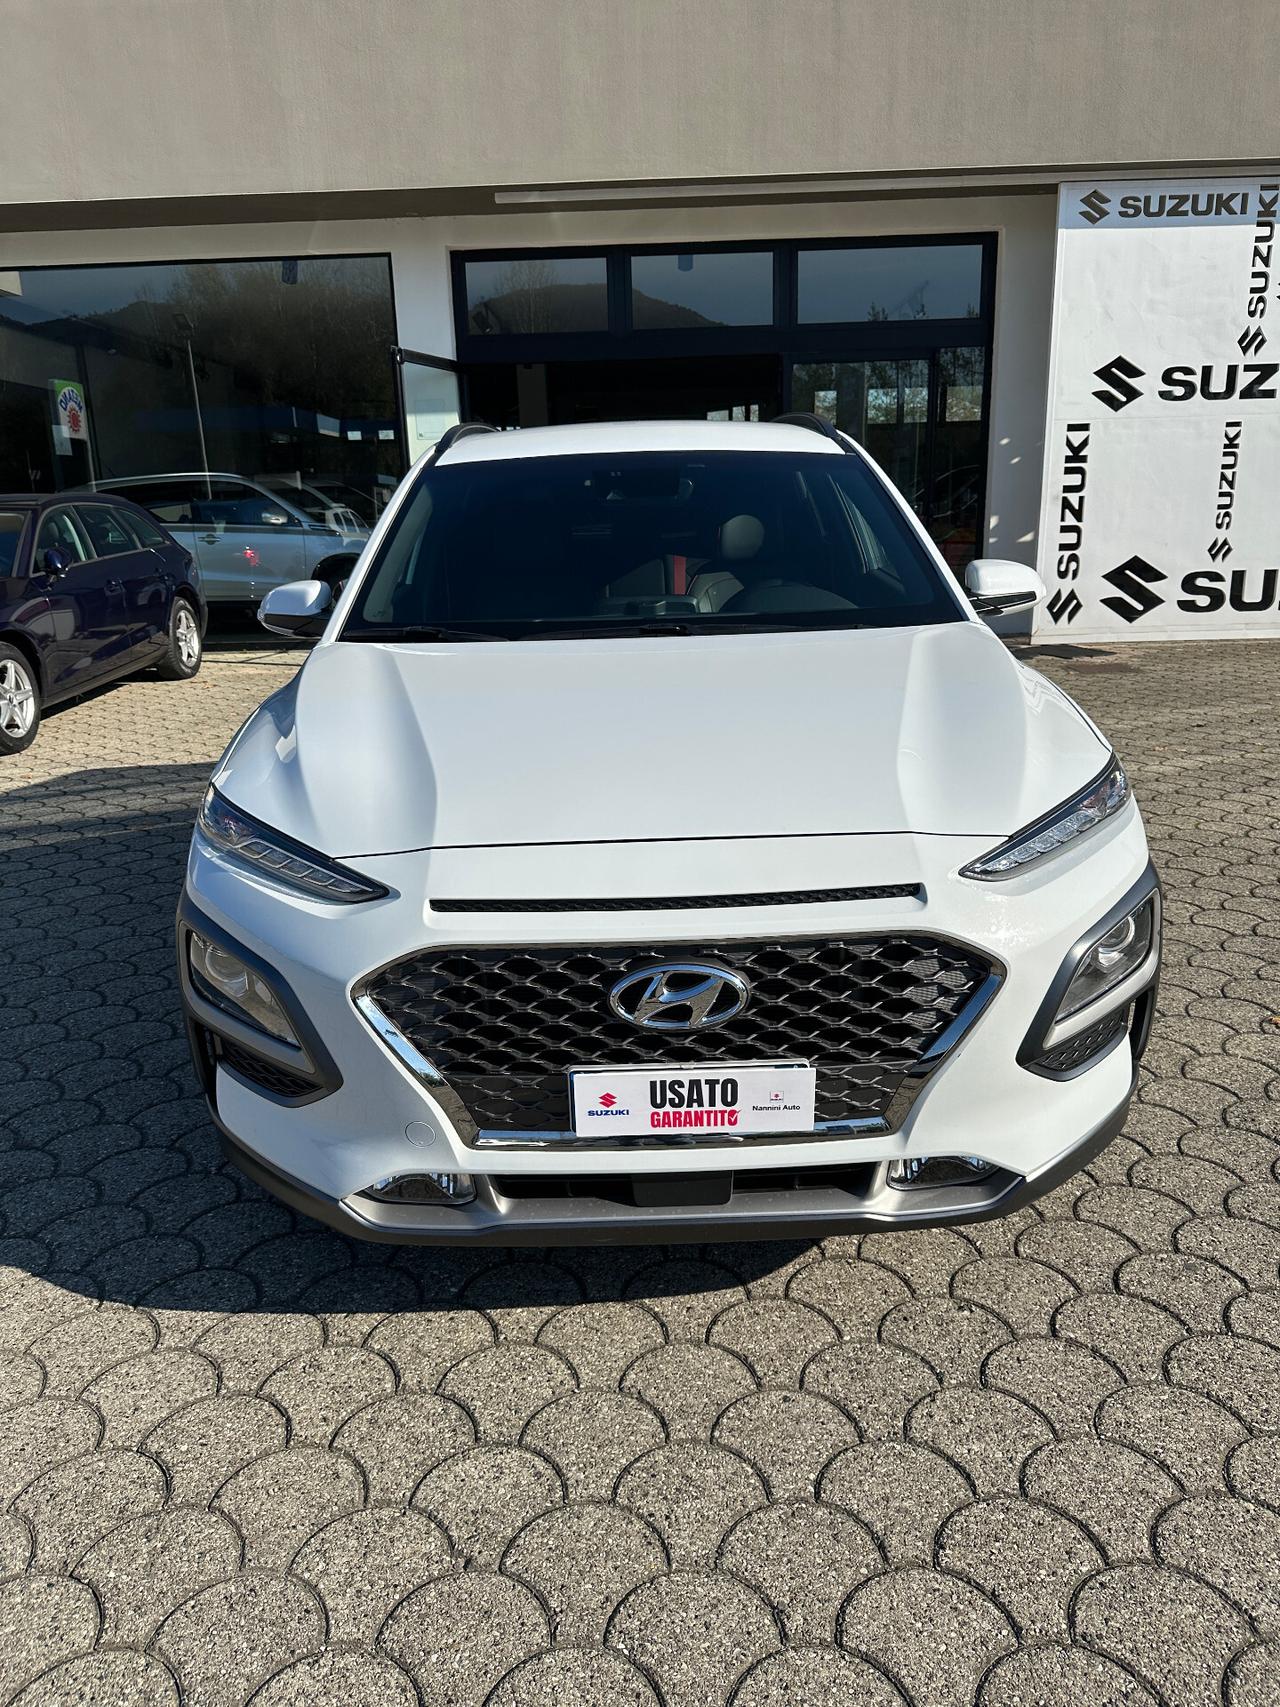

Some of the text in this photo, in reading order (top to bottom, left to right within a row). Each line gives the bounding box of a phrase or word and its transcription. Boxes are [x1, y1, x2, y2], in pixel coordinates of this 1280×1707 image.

[1118, 192, 1250, 218] SUZUKI
[1248, 184, 1280, 318] SUZUKI
[1157, 363, 1280, 402] SUZ
[1215, 420, 1243, 531] SUZUKI
[1056, 422, 1091, 581] SUZUKI
[649, 1077, 739, 1109] USATO
[587, 1109, 630, 1117] SUZUKI
[650, 1109, 740, 1128] GARANTITO
